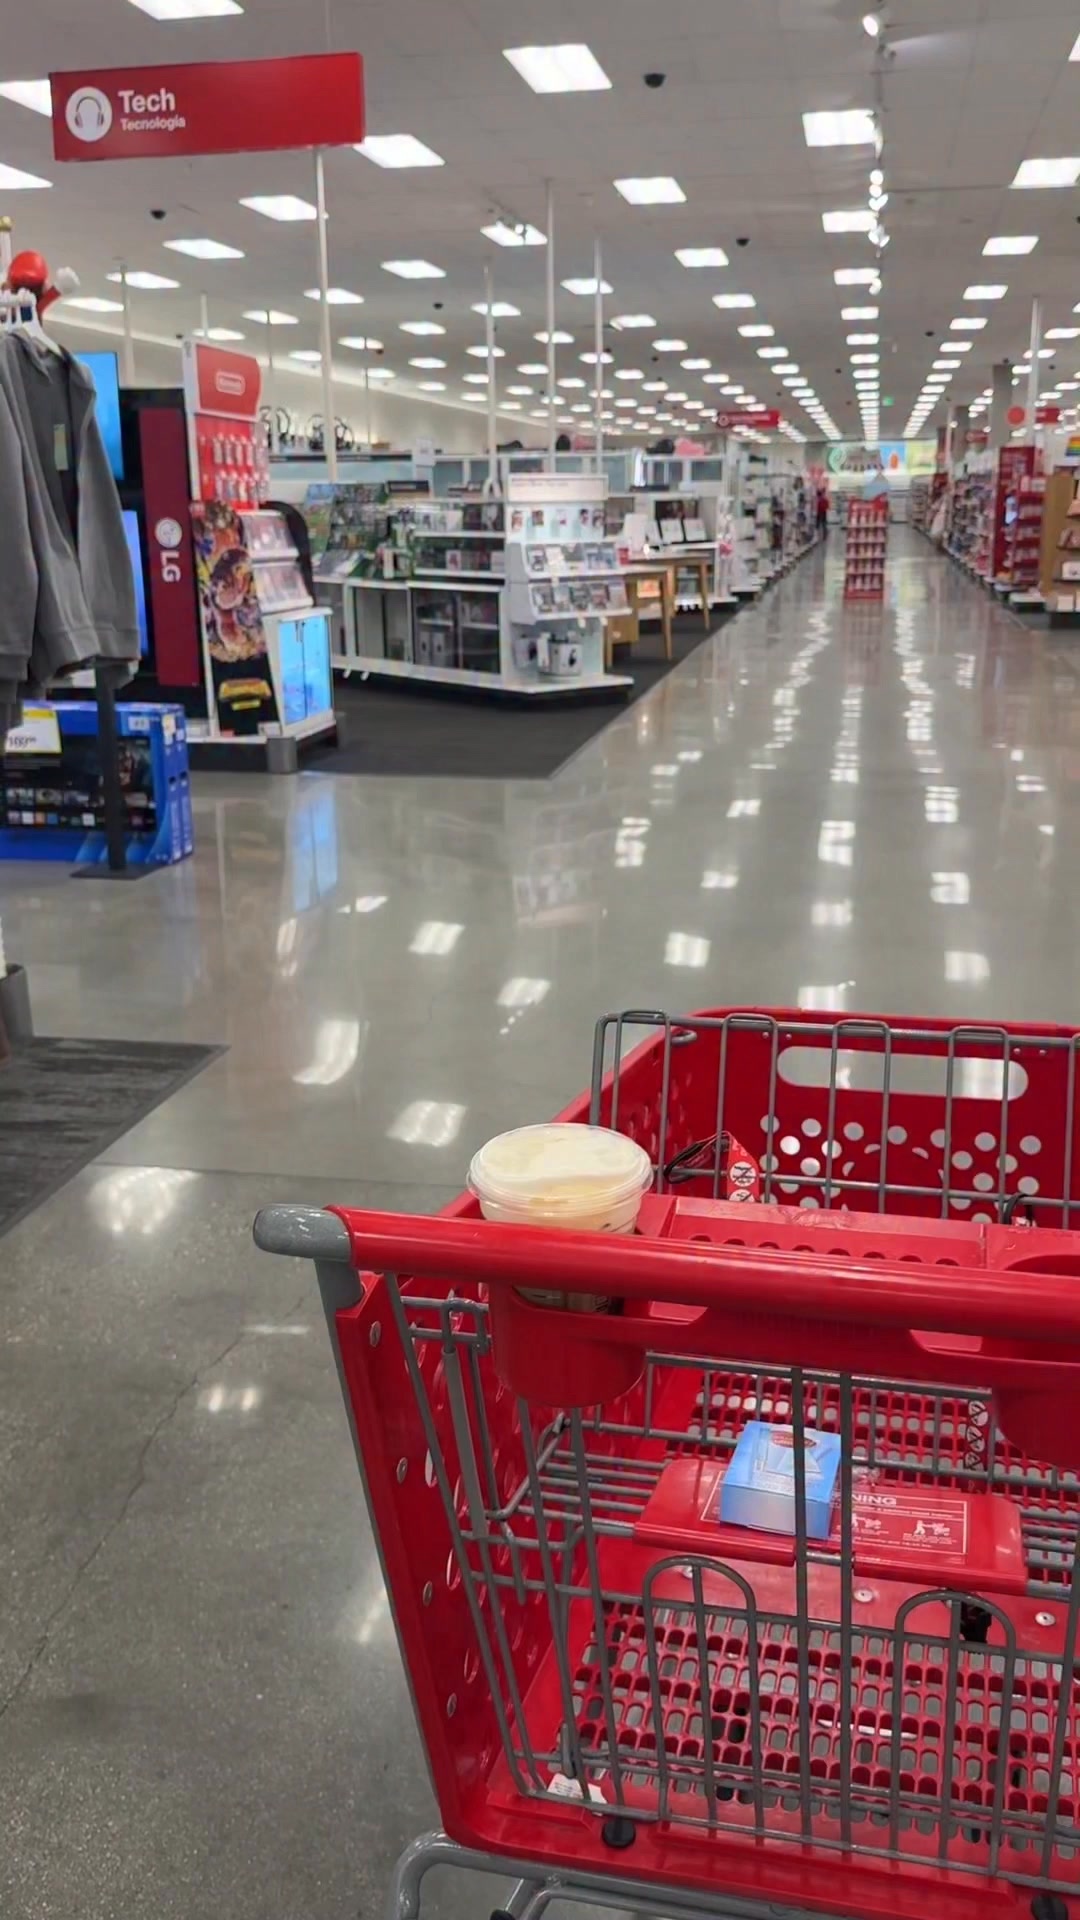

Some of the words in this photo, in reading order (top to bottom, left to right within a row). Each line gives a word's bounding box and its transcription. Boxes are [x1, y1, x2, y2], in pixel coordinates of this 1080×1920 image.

[118, 88, 175, 113] Tech
[120, 115, 186, 131] Tecnología
[161, 551, 181, 583] LG
